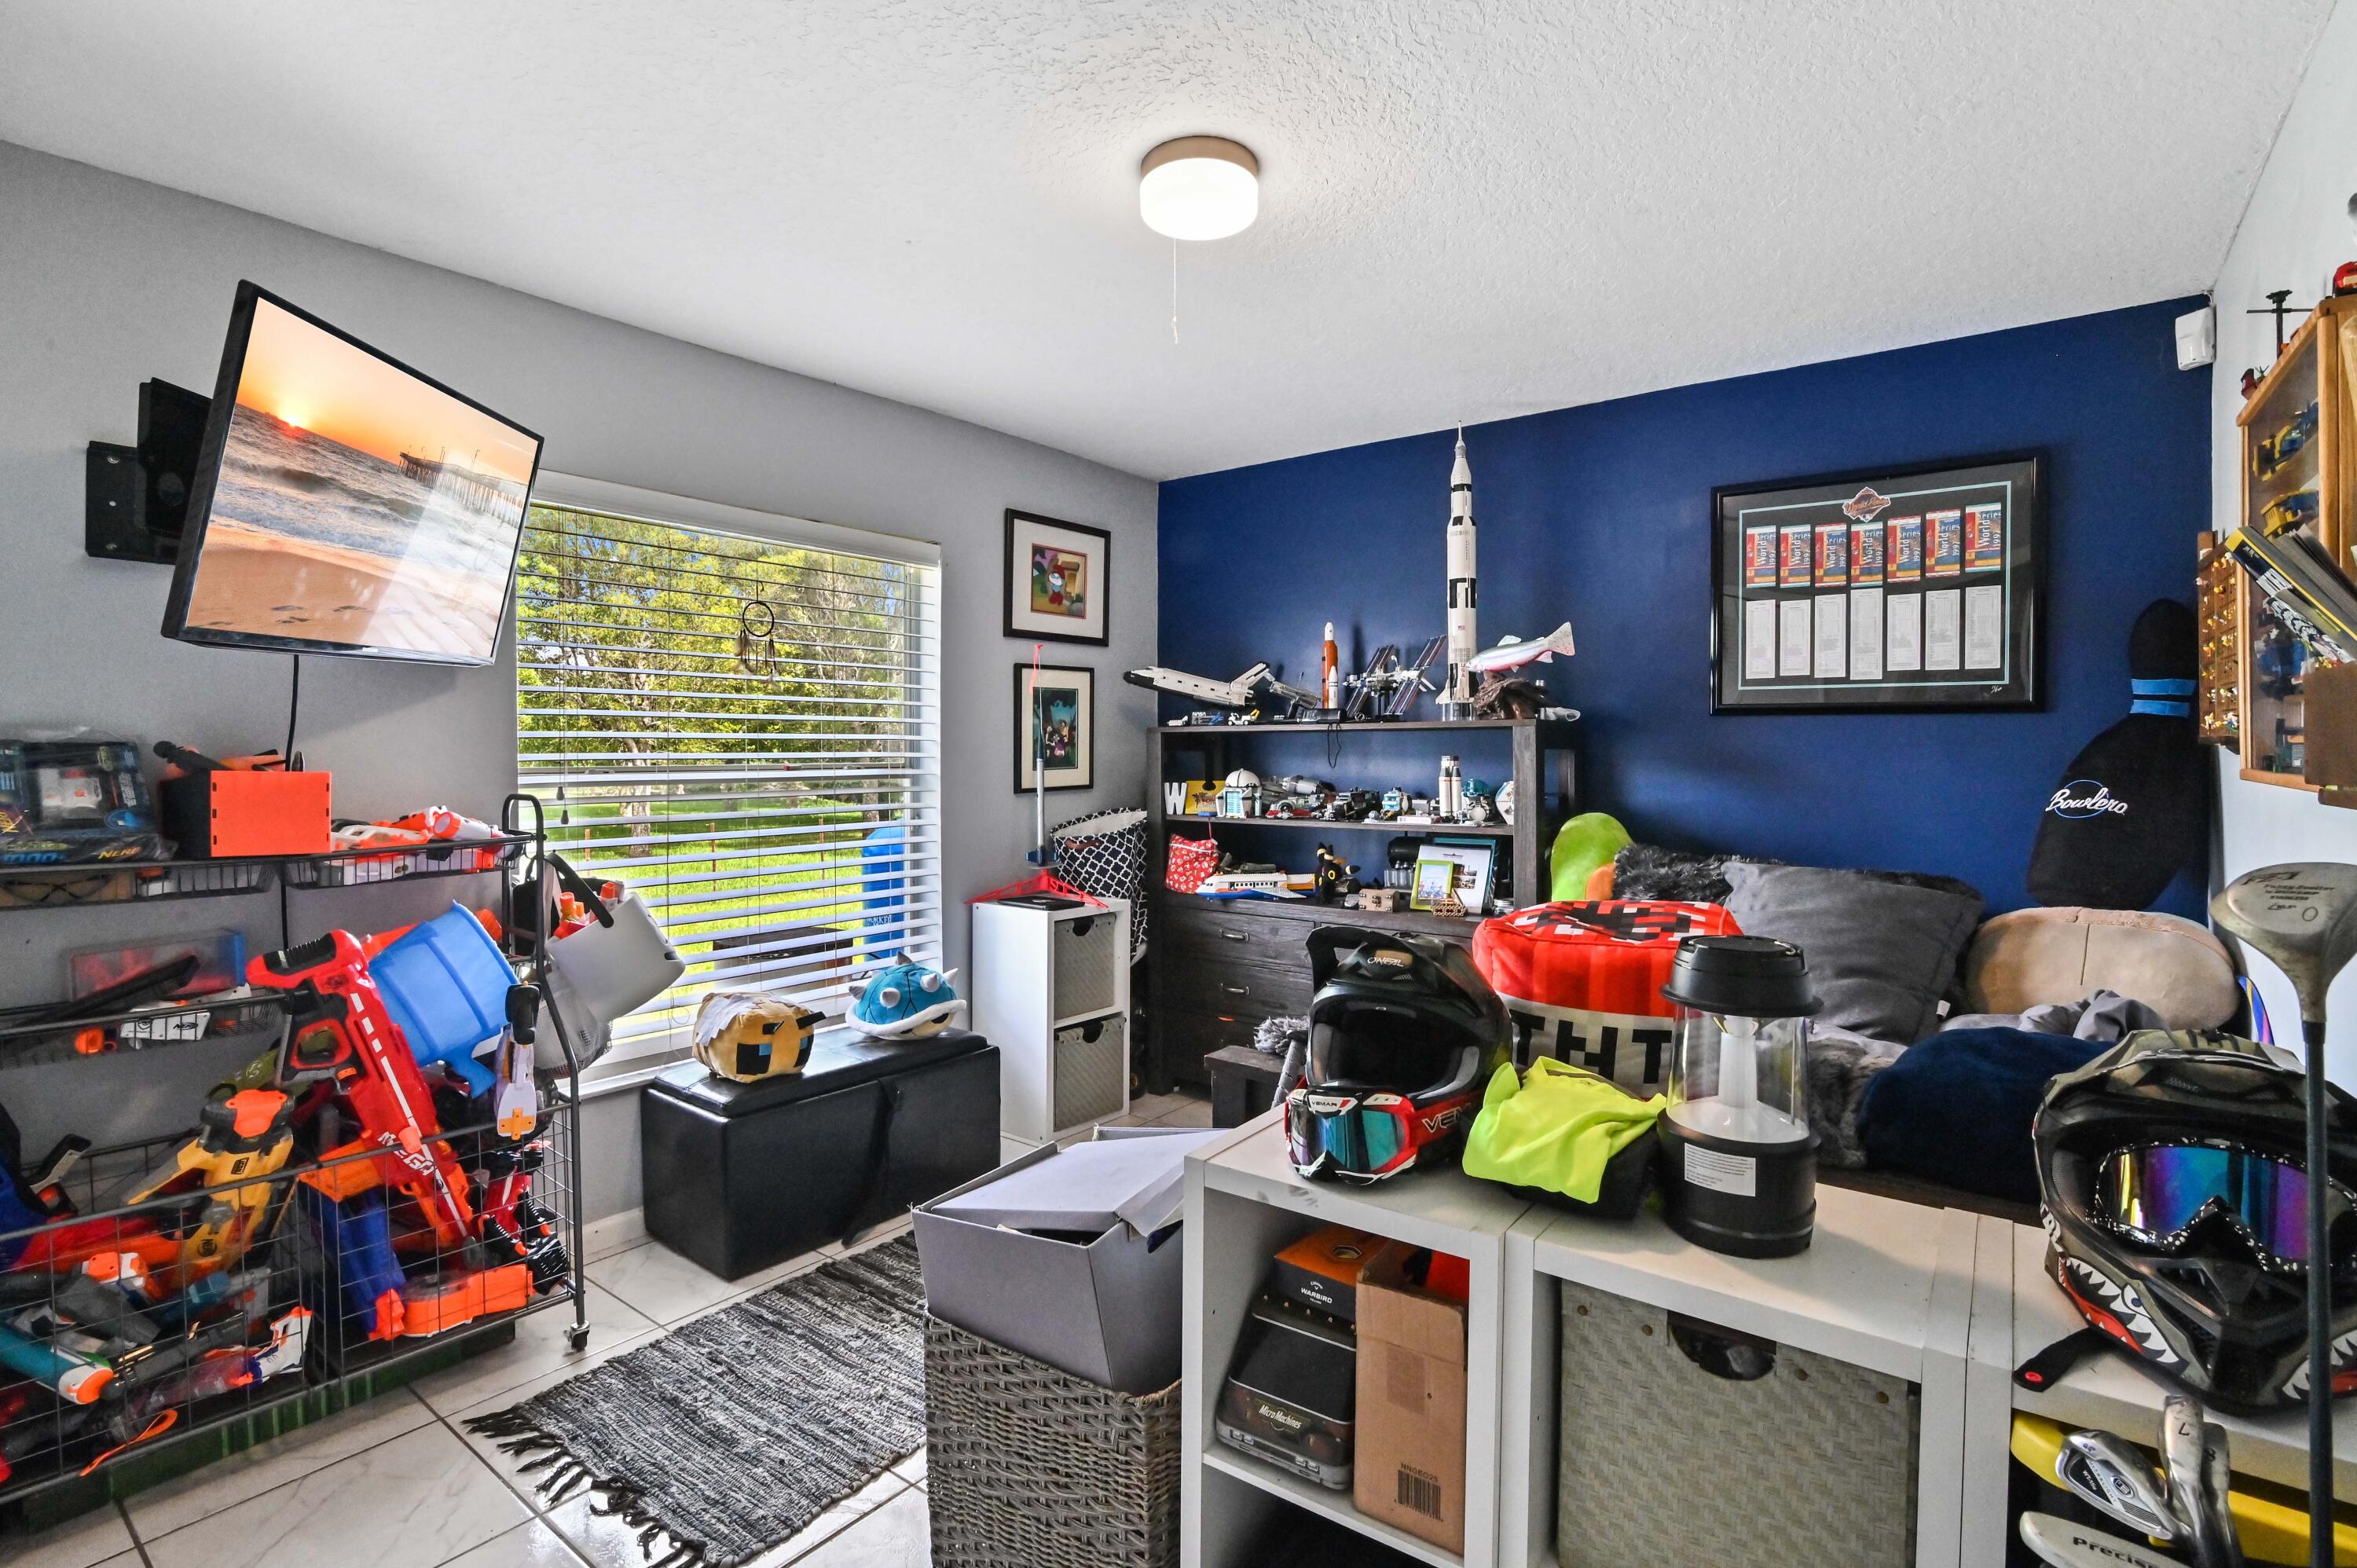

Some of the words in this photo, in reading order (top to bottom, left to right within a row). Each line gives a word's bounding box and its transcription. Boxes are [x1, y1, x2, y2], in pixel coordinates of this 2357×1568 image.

[1936, 533, 1948, 558] World
[1978, 519, 1990, 548] World
[1757, 540, 1766, 566] World
[1791, 540, 1801, 566] World
[1826, 545, 1835, 569] World
[1863, 538, 1873, 564] World
[1898, 539, 1909, 563] World
[1164, 782, 1188, 815] W
[2045, 786, 2128, 816] Bowlero
[97, 847, 142, 859] NERF
[1300, 1287, 1332, 1304] WARBIRD
[1259, 1405, 1276, 1419] Micro
[1274, 1410, 1302, 1429] Machines
